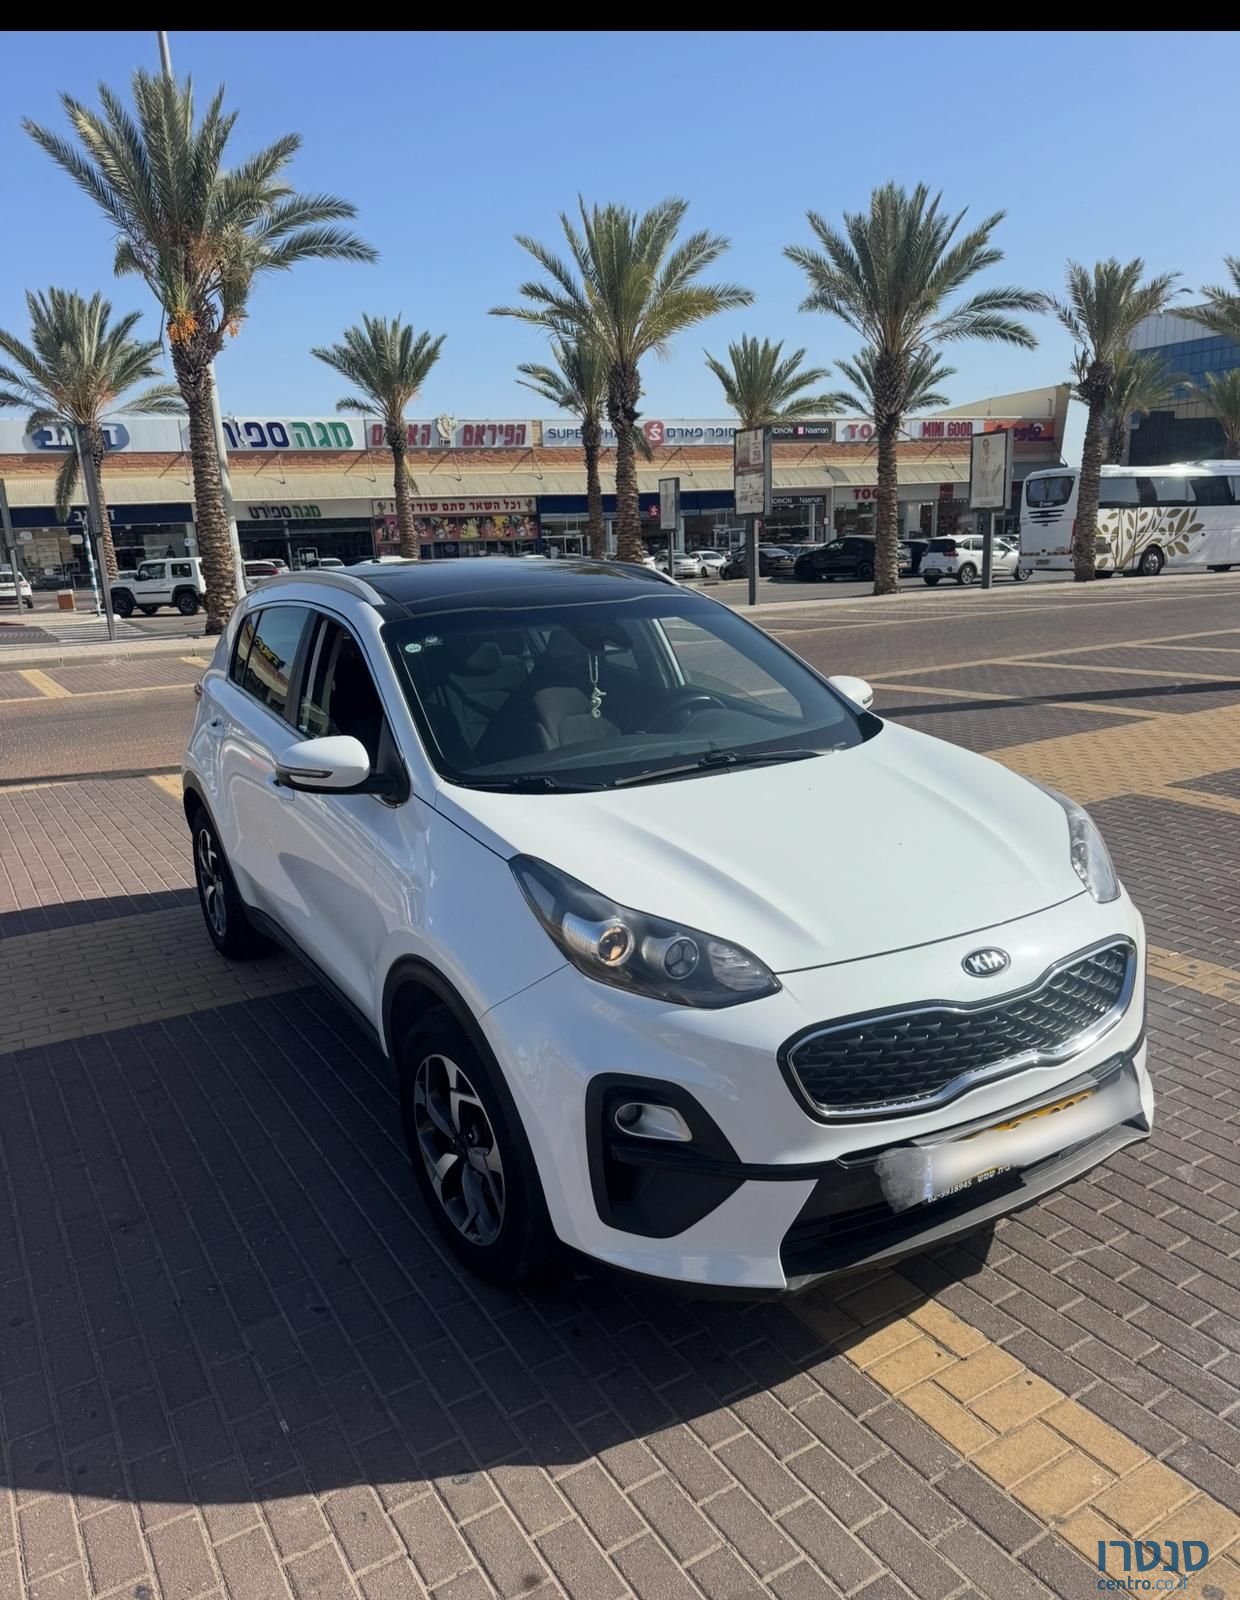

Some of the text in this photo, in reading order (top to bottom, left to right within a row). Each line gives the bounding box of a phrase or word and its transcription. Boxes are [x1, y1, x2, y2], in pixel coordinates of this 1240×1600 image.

[222, 421, 354, 448] מגה ספור
[371, 424, 526, 446] הפיראם האם
[922, 421, 973, 437] MINI GOOD
[248, 505, 322, 519] מגה ספורט
[441, 502, 466, 512] סתם
[469, 501, 499, 511] השאר
[503, 499, 521, 510] וכל
[968, 951, 1005, 973] KIA
